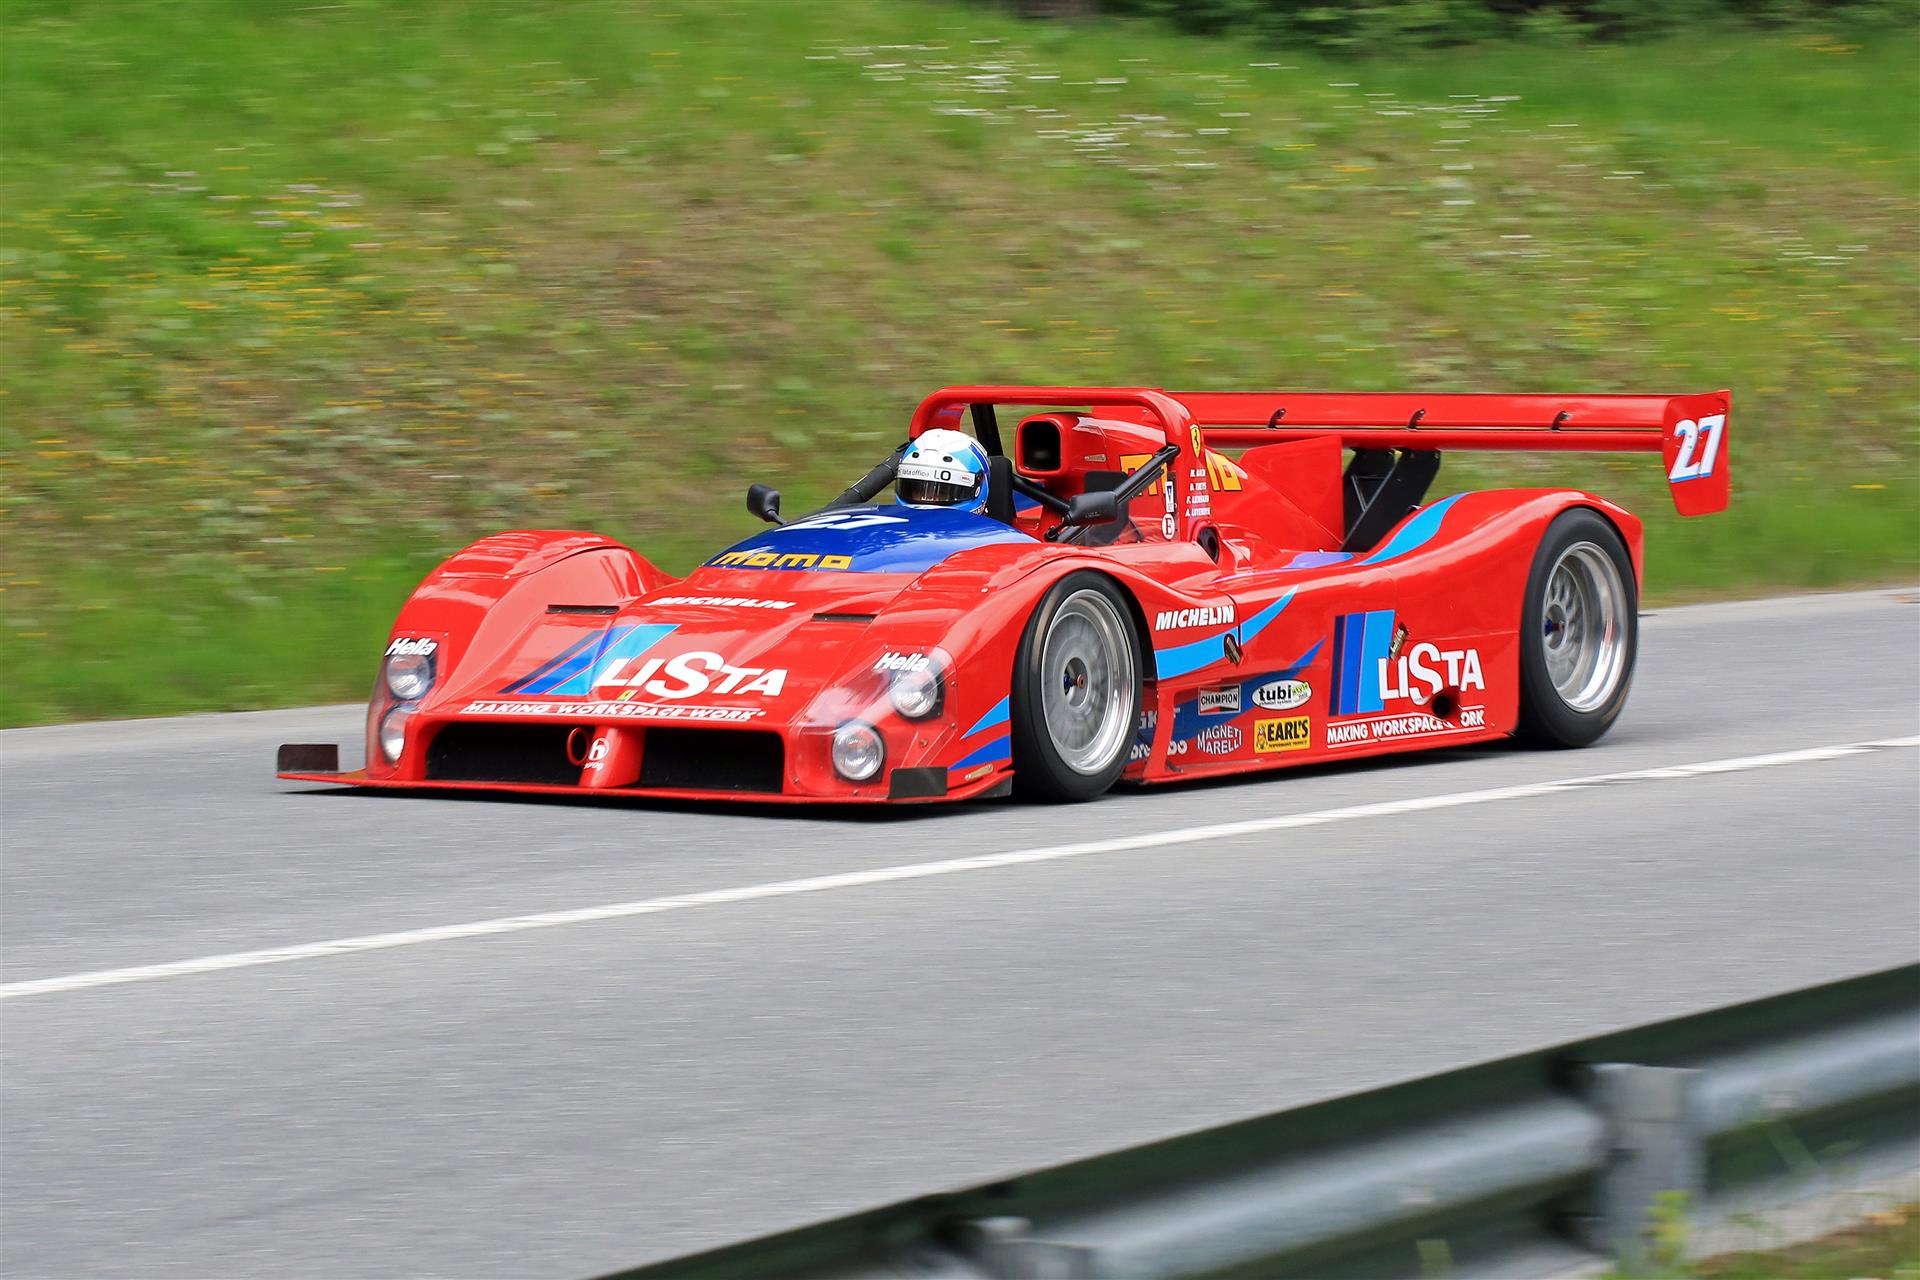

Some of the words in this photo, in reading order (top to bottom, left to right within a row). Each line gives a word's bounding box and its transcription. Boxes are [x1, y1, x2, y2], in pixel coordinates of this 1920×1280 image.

[1668, 414, 1726, 483] 27
[934, 470, 951, 481] LO
[774, 515, 909, 532] 27
[711, 551, 853, 570] momo
[642, 596, 796, 609] MICHELIN
[1155, 606, 1235, 631] MICHELIN
[385, 638, 438, 656] Hella
[873, 652, 930, 672] Hella
[592, 651, 788, 699] LISTA
[1378, 642, 1486, 706] LISTA
[1201, 694, 1238, 705] CHAMPION
[1259, 685, 1291, 701] tubi
[462, 703, 552, 714] MAKING
[557, 703, 684, 718] WORKSPACE
[689, 709, 757, 721] WORK
[1197, 725, 1242, 747] MAGNETI
[1268, 719, 1308, 742] EARL'S
[1327, 723, 1369, 744] MAKING
[1371, 717, 1445, 738] WORKSPACE
[1197, 732, 1242, 755] MARELLI
